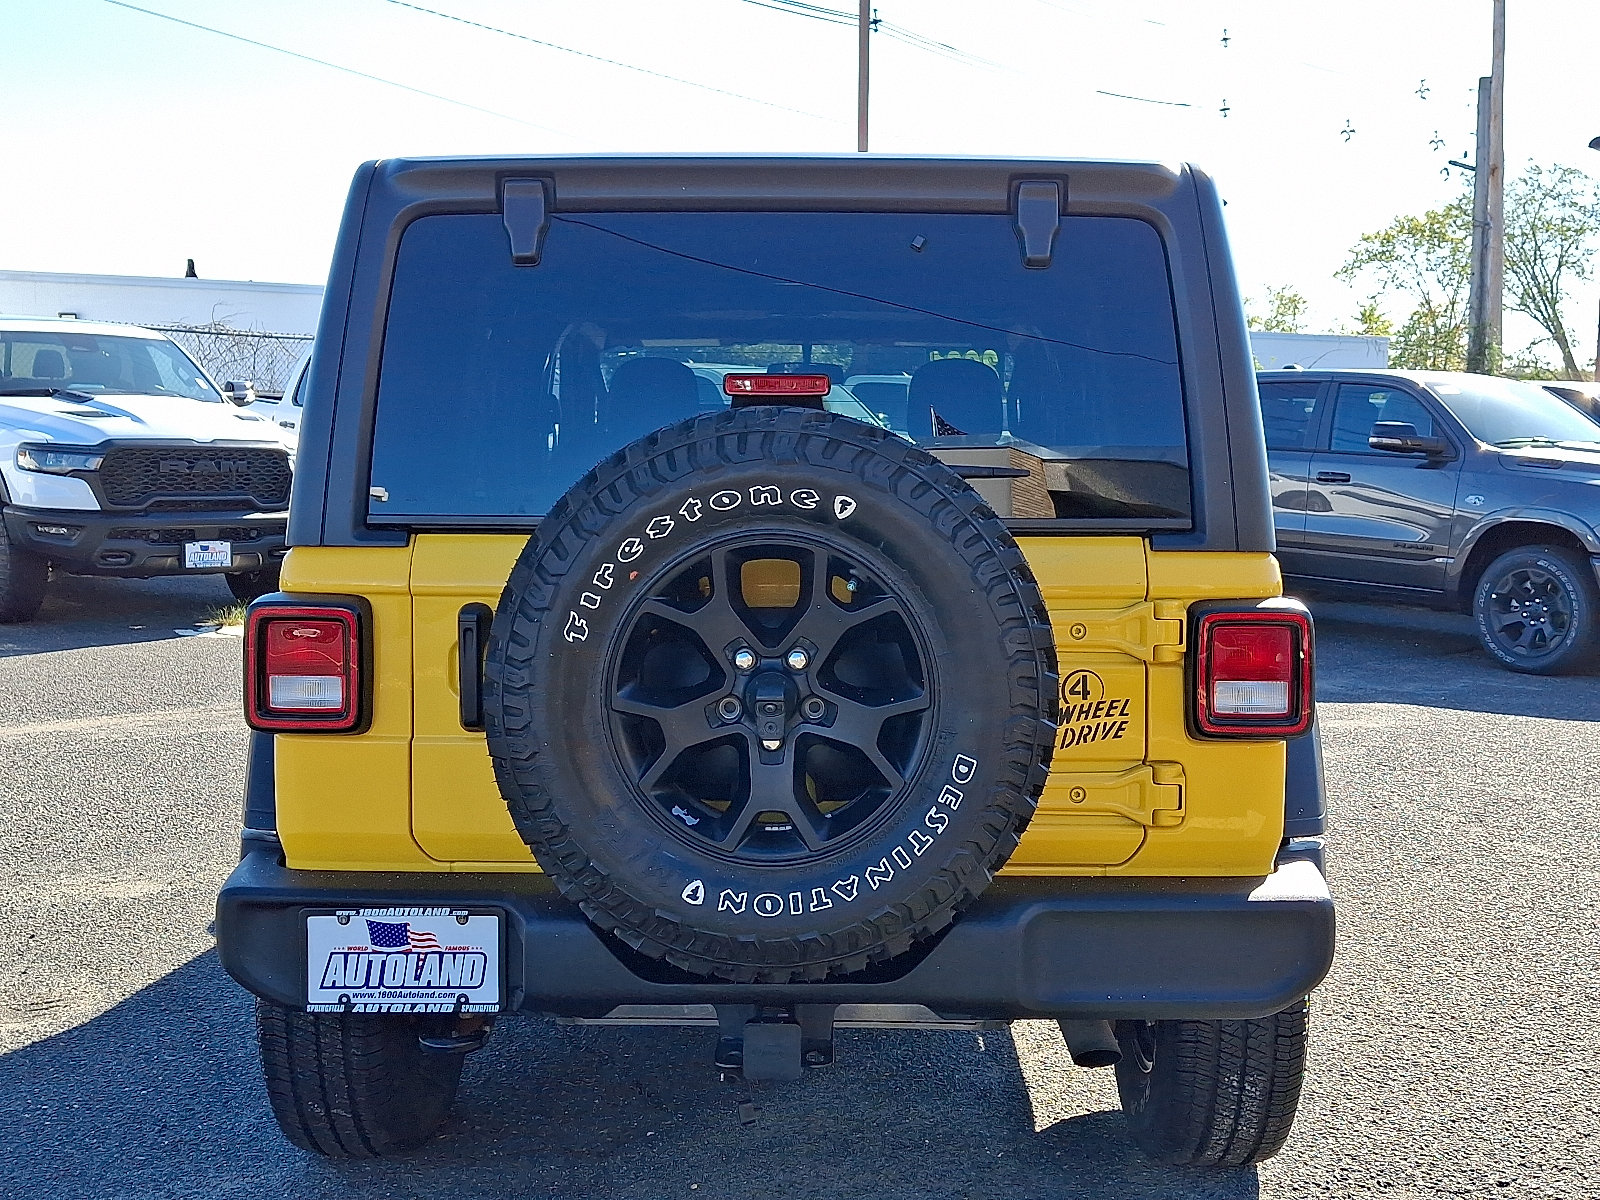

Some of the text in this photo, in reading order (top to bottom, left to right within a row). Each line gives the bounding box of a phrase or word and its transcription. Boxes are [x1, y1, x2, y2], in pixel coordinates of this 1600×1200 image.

[160, 460, 247, 472] RAM
[188, 552, 228, 562] AUTOLAND
[563, 484, 821, 643] Firestone
[1069, 674, 1091, 701] 4
[1059, 698, 1131, 727] WHEEL
[1059, 720, 1130, 750] DRIVE
[717, 752, 978, 917] DESTINATION
[320, 951, 487, 989] AUTOLAND
[306, 1003, 500, 1012] SPRINGFIELD AUTOLAND SPRINGFIELD
[352, 990, 456, 999] www.1800Autoland.com
